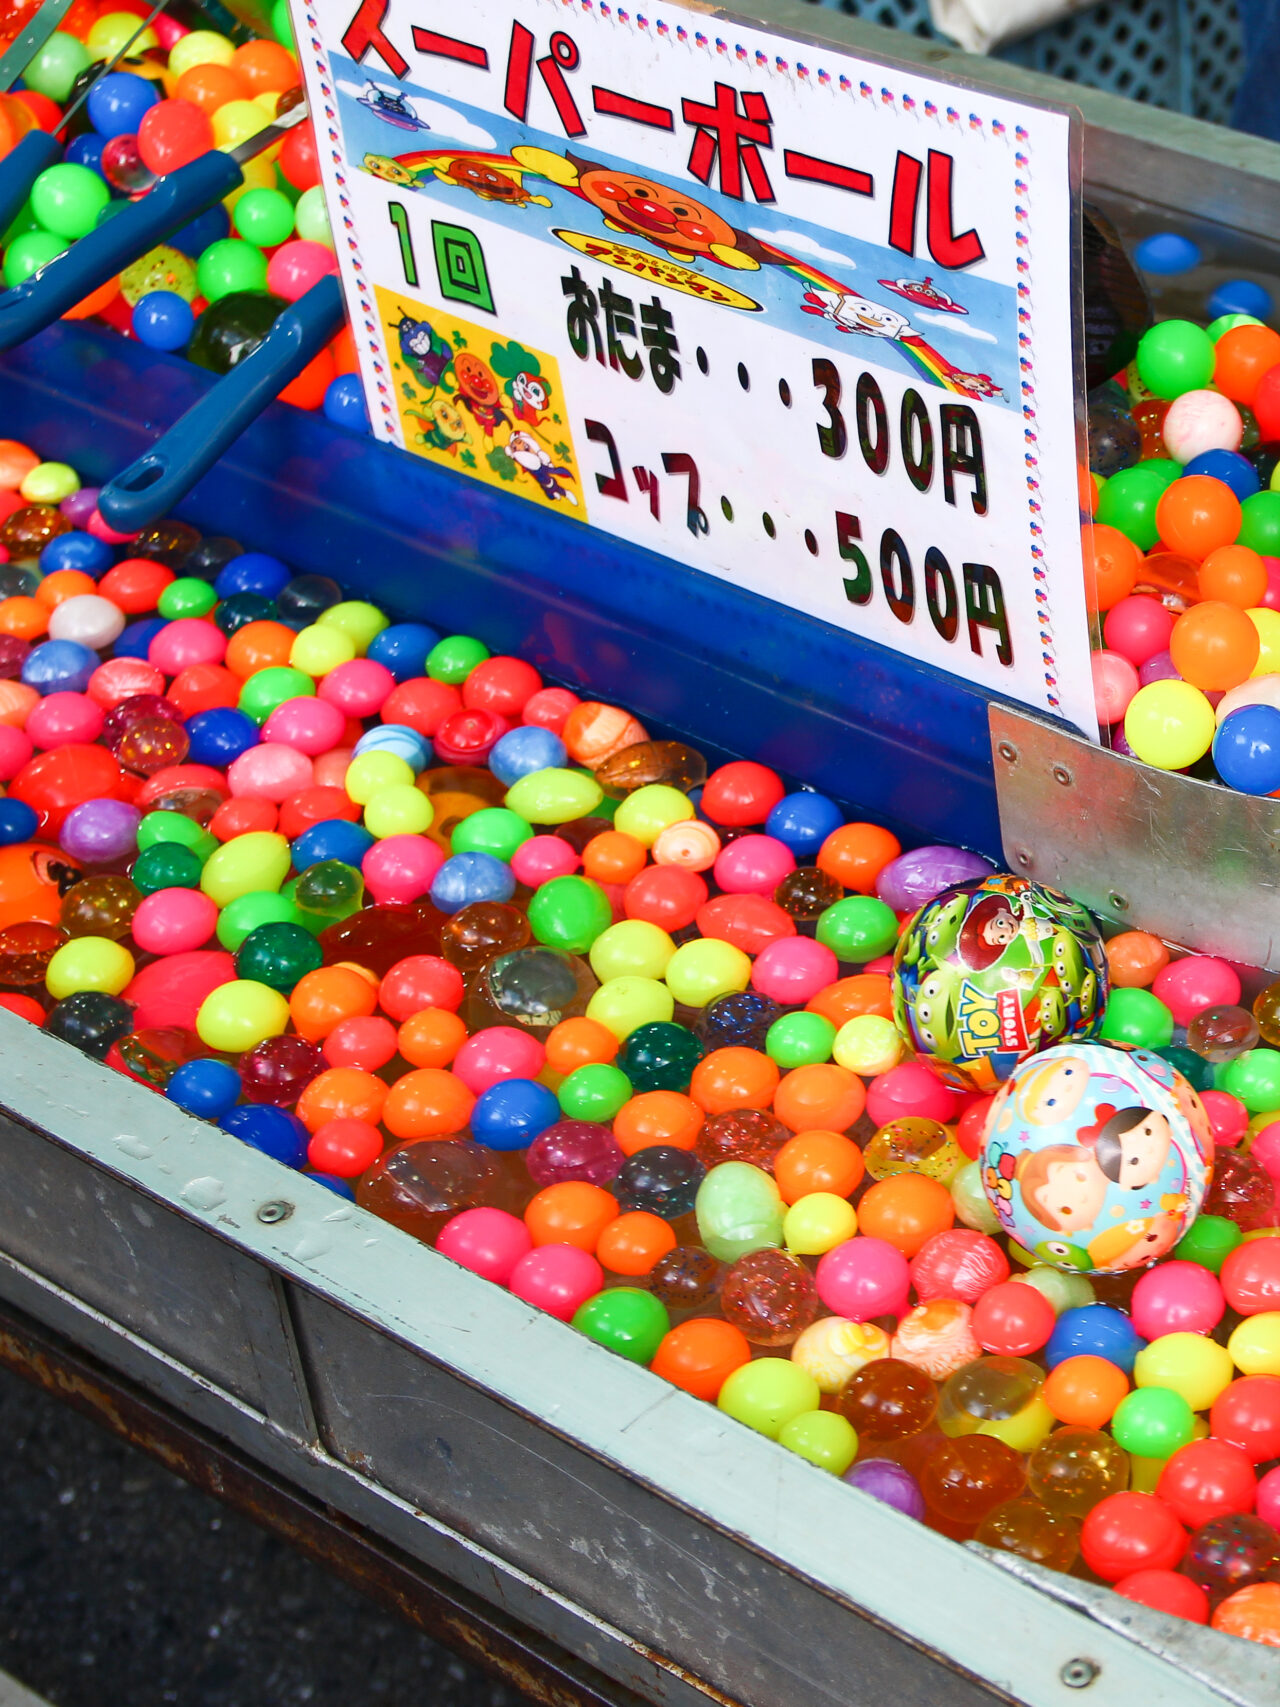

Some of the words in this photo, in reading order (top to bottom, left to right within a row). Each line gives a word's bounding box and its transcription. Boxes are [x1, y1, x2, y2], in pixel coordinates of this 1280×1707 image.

[585, 243, 731, 302] アンパンマン
[962, 981, 1001, 1058] TOY
[1001, 993, 1019, 1048] STORY
